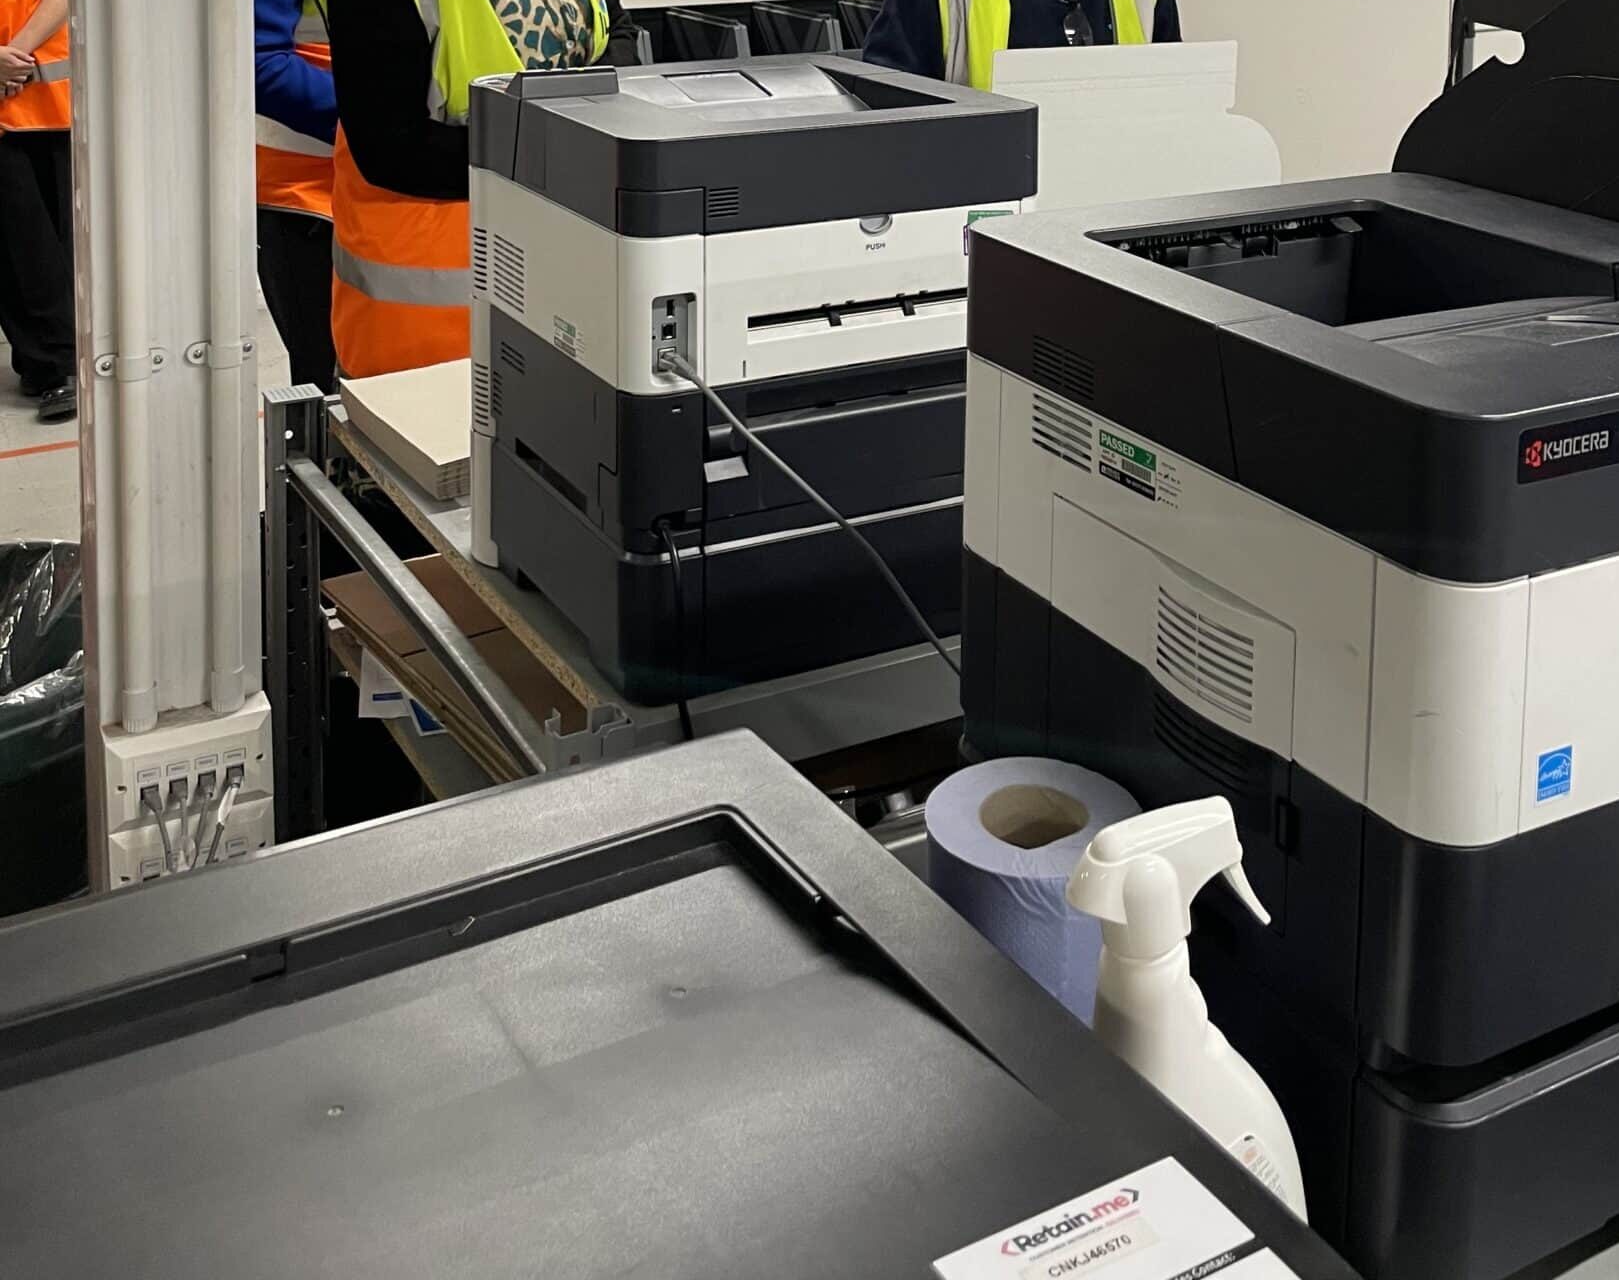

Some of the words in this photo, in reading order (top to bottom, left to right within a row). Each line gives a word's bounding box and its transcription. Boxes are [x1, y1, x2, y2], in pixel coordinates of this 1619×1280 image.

[866, 242, 886, 251] PUSH
[1101, 433, 1135, 457] PASSED
[1543, 430, 1609, 461] KYOCERA
[1013, 1194, 1131, 1252] Retain.me
